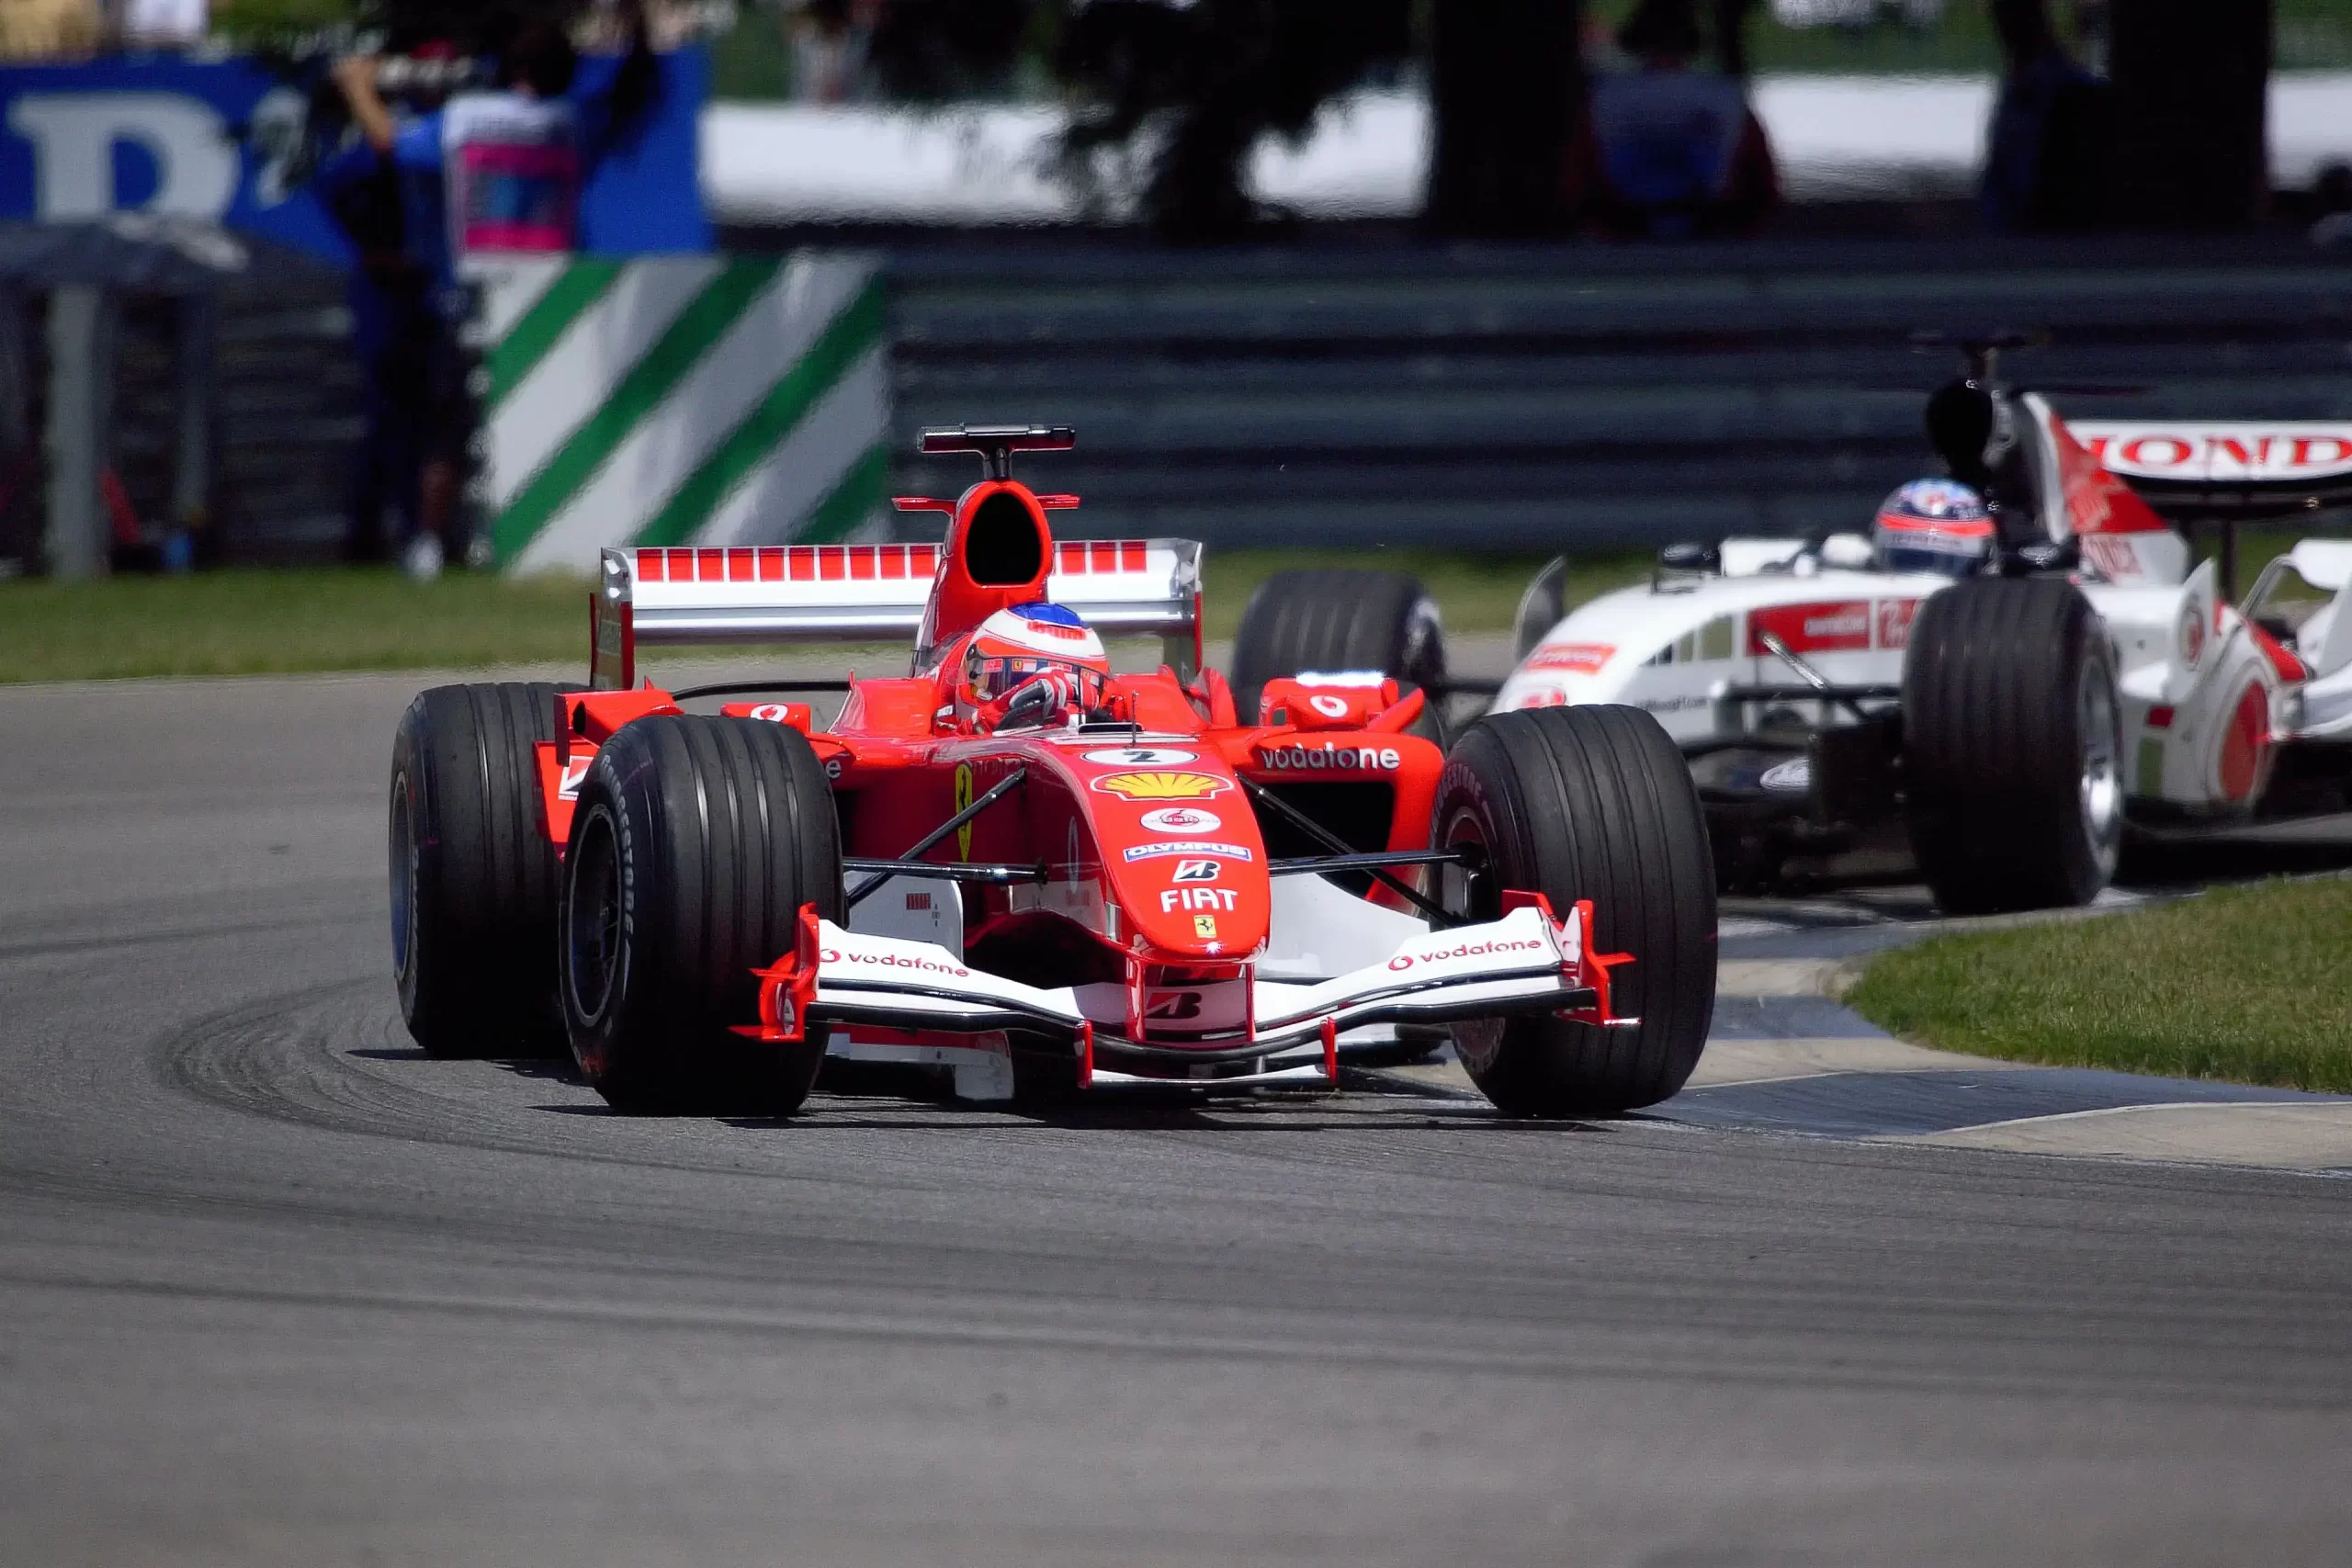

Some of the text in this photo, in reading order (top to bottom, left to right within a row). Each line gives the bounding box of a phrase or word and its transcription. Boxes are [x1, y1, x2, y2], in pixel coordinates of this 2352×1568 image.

[1123, 750, 1161, 762] 2
[1261, 741, 1400, 769] vodafone
[1127, 842, 1248, 857] OLYMPUS
[1160, 887, 1238, 913] FIAT
[1419, 940, 1543, 963] vodafone
[848, 953, 970, 977] vodafone
